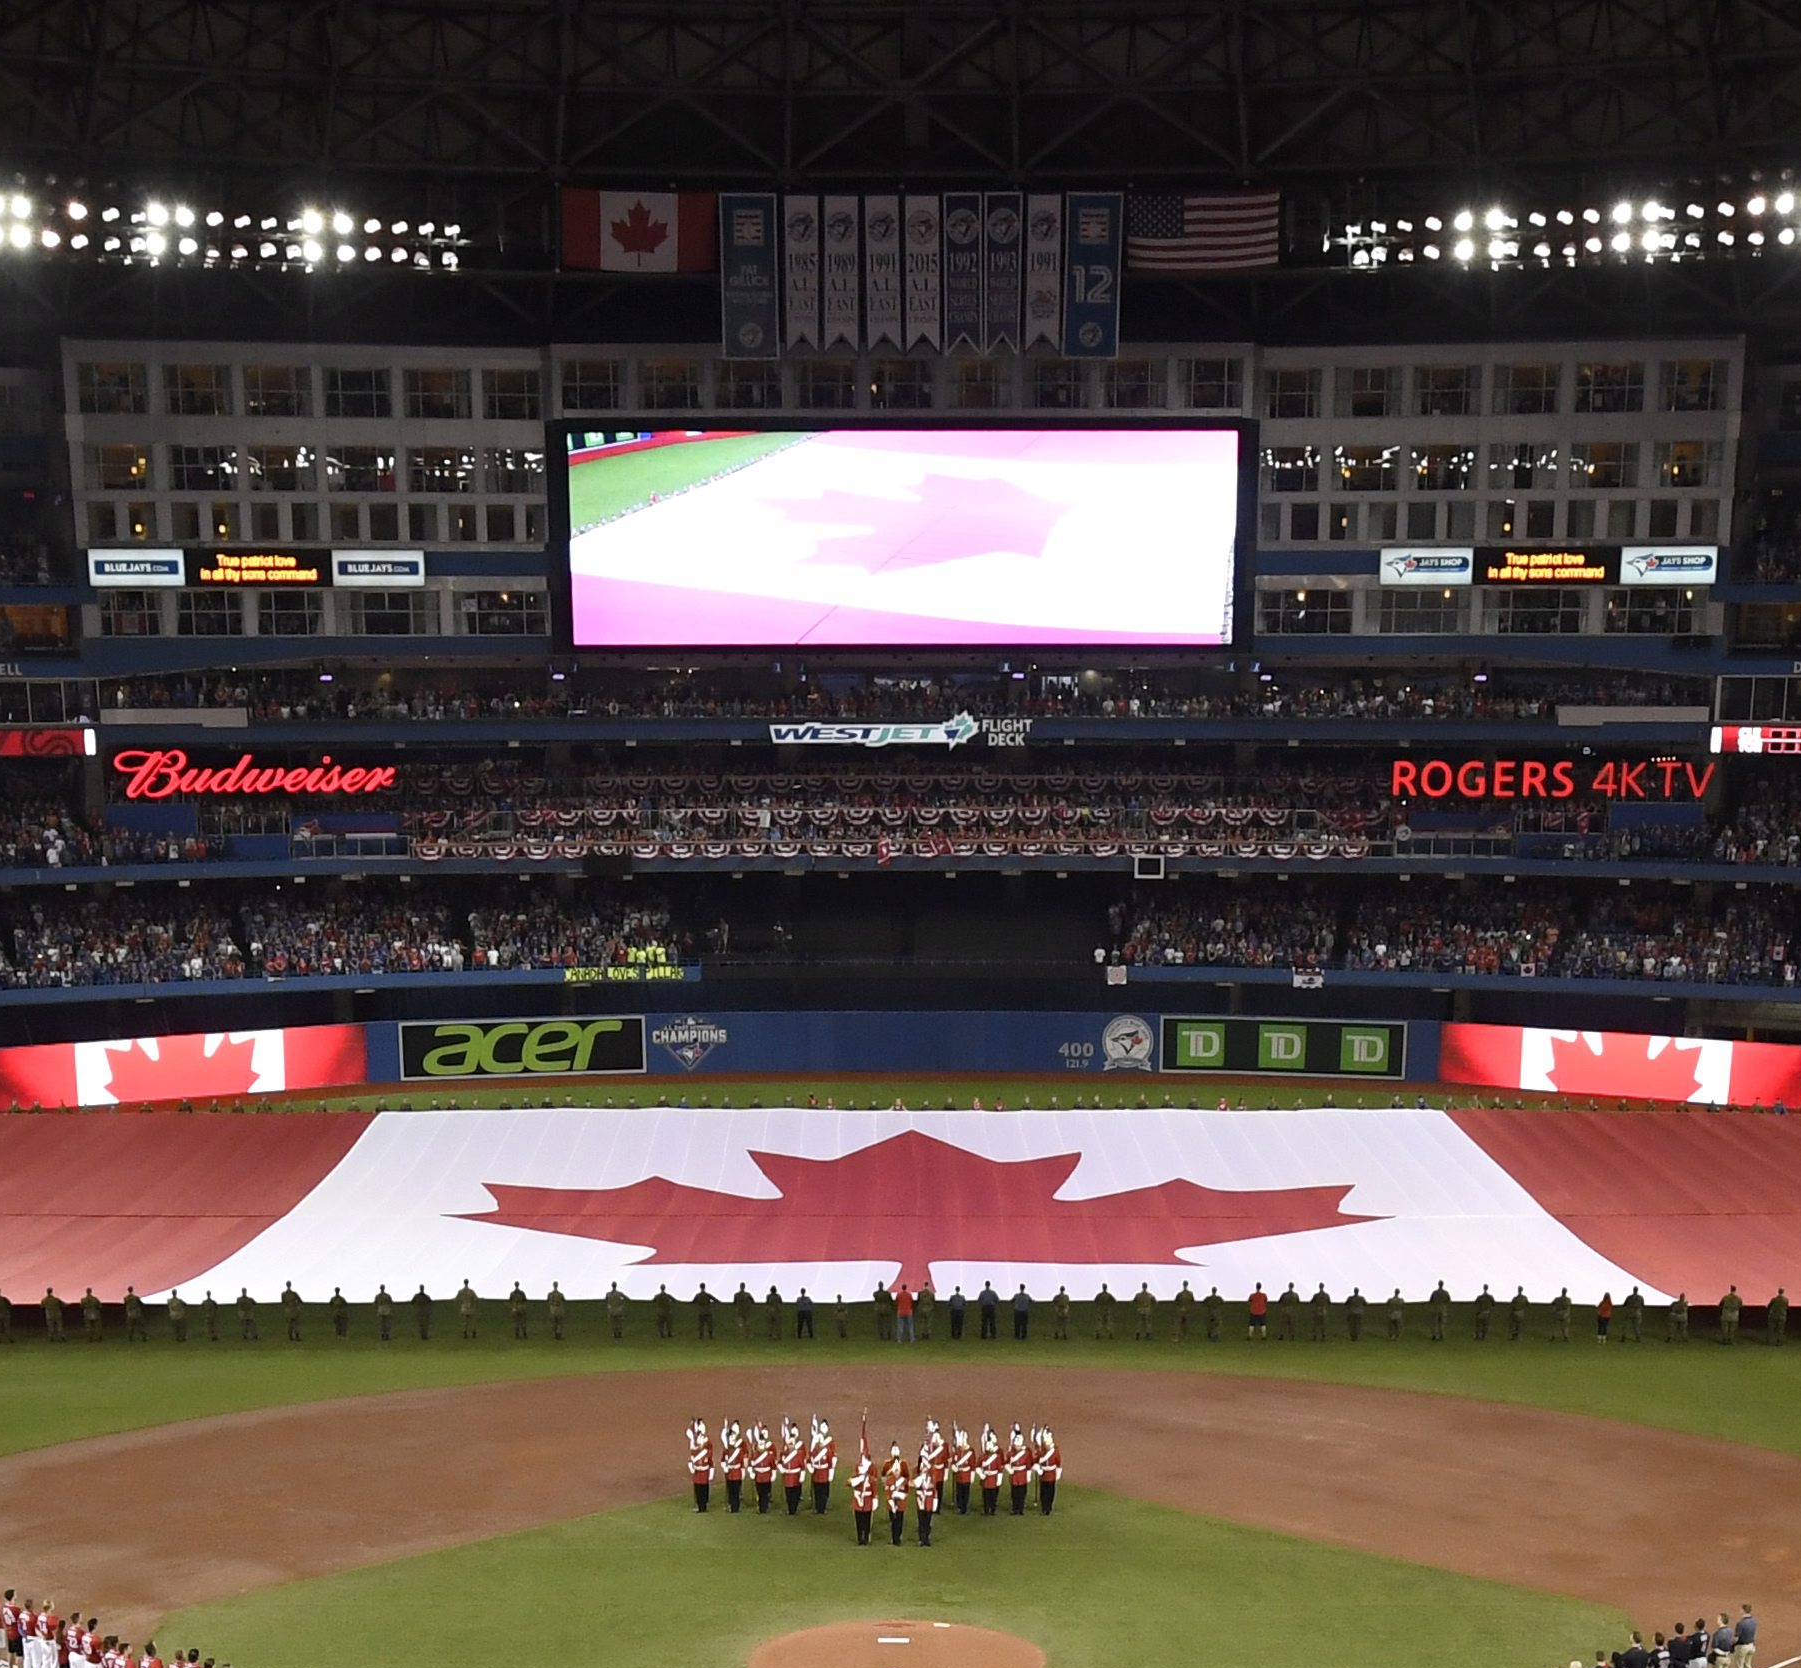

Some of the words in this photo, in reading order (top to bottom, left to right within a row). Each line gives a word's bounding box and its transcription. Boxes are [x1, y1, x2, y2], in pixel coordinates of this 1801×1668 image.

[789, 253, 816, 272] 1985
[828, 253, 854, 272] 1989
[870, 253, 896, 272] 1991
[908, 253, 938, 272] 2015
[950, 253, 976, 272] 1992
[990, 253, 1016, 272] 1993
[1072, 265, 1112, 303] 12
[790, 296, 814, 311] EAST
[828, 296, 854, 311] EAST
[870, 296, 896, 311] EAST
[909, 296, 937, 311] EAST
[216, 554, 238, 566] True
[242, 554, 273, 569] patriot
[275, 554, 296, 566] love
[1419, 557, 1440, 567] JAYS
[1440, 557, 1463, 566] SHOP
[1506, 553, 1528, 565] True
[1530, 553, 1562, 567] patriot
[1563, 553, 1584, 565] love
[1661, 556, 1682, 566] JAYS
[1683, 555, 1706, 566] SHOP
[267, 568, 317, 581] command
[1513, 566, 1527, 581] thy
[1529, 569, 1553, 580] sons
[1554, 567, 1604, 579] command
[982, 718, 1033, 733] FLIGHT
[772, 726, 940, 747] WESTJET
[988, 733, 1026, 747] DECK
[113, 749, 397, 799] Budweiser
[1391, 760, 1575, 798] ROGERS
[564, 966, 603, 981] CANADA
[607, 966, 639, 981] LOVES
[652, 1029, 727, 1044] CHAMPIONS
[1181, 1030, 1220, 1057] TD
[422, 1020, 623, 1075] acer
[1058, 1041, 1094, 1057] 400
[1263, 1032, 1300, 1060] TD
[1345, 1034, 1384, 1062] TD
